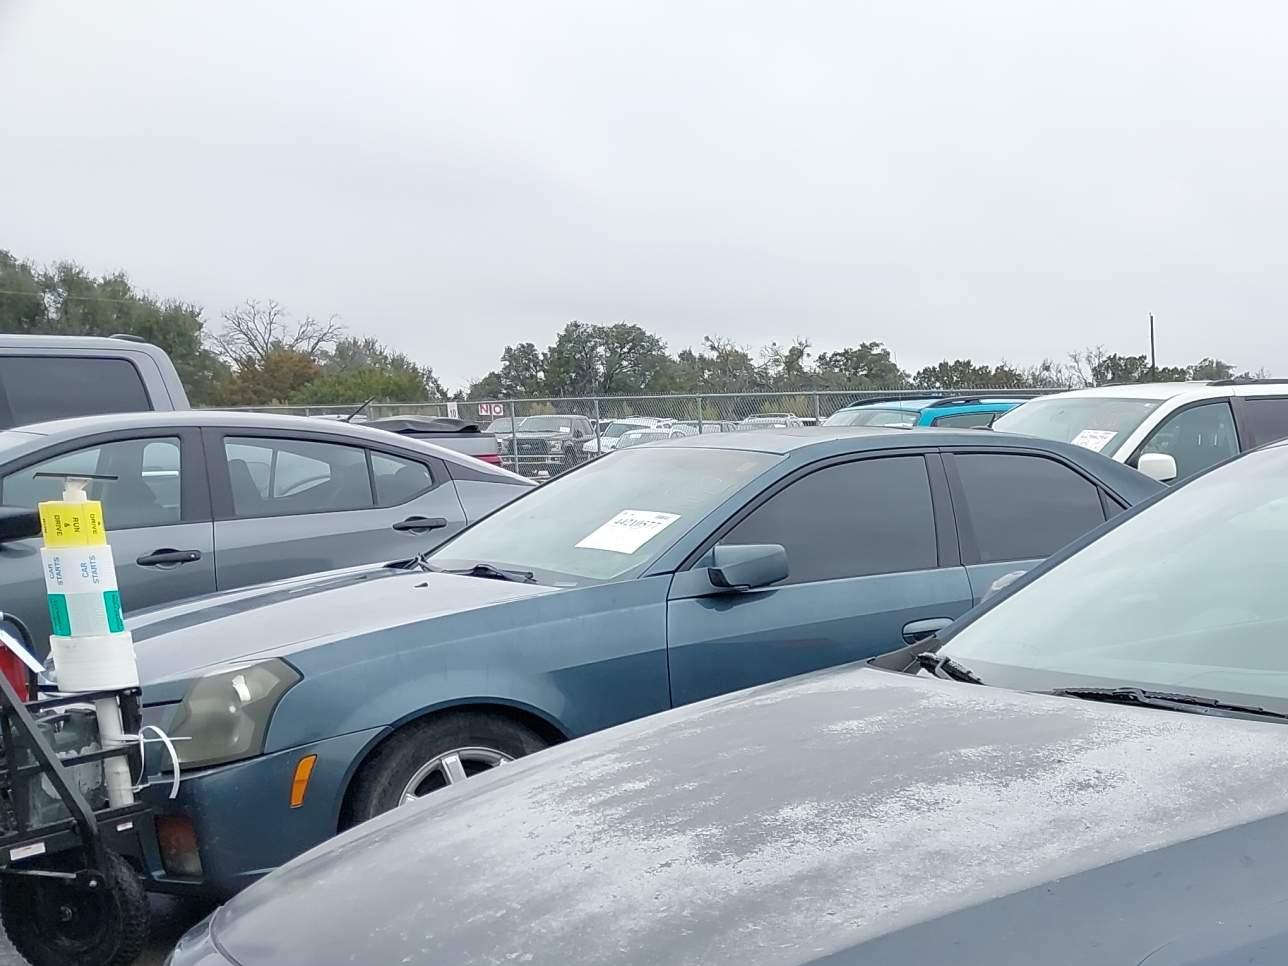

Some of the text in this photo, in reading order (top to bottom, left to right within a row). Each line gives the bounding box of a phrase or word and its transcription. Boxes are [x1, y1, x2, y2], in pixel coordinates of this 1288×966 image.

[54, 514, 63, 537] DRIVE
[72, 517, 81, 533] RUN
[53, 556, 64, 585] STARTS
[80, 562, 89, 578] CAR
[89, 554, 100, 584] STARTS
